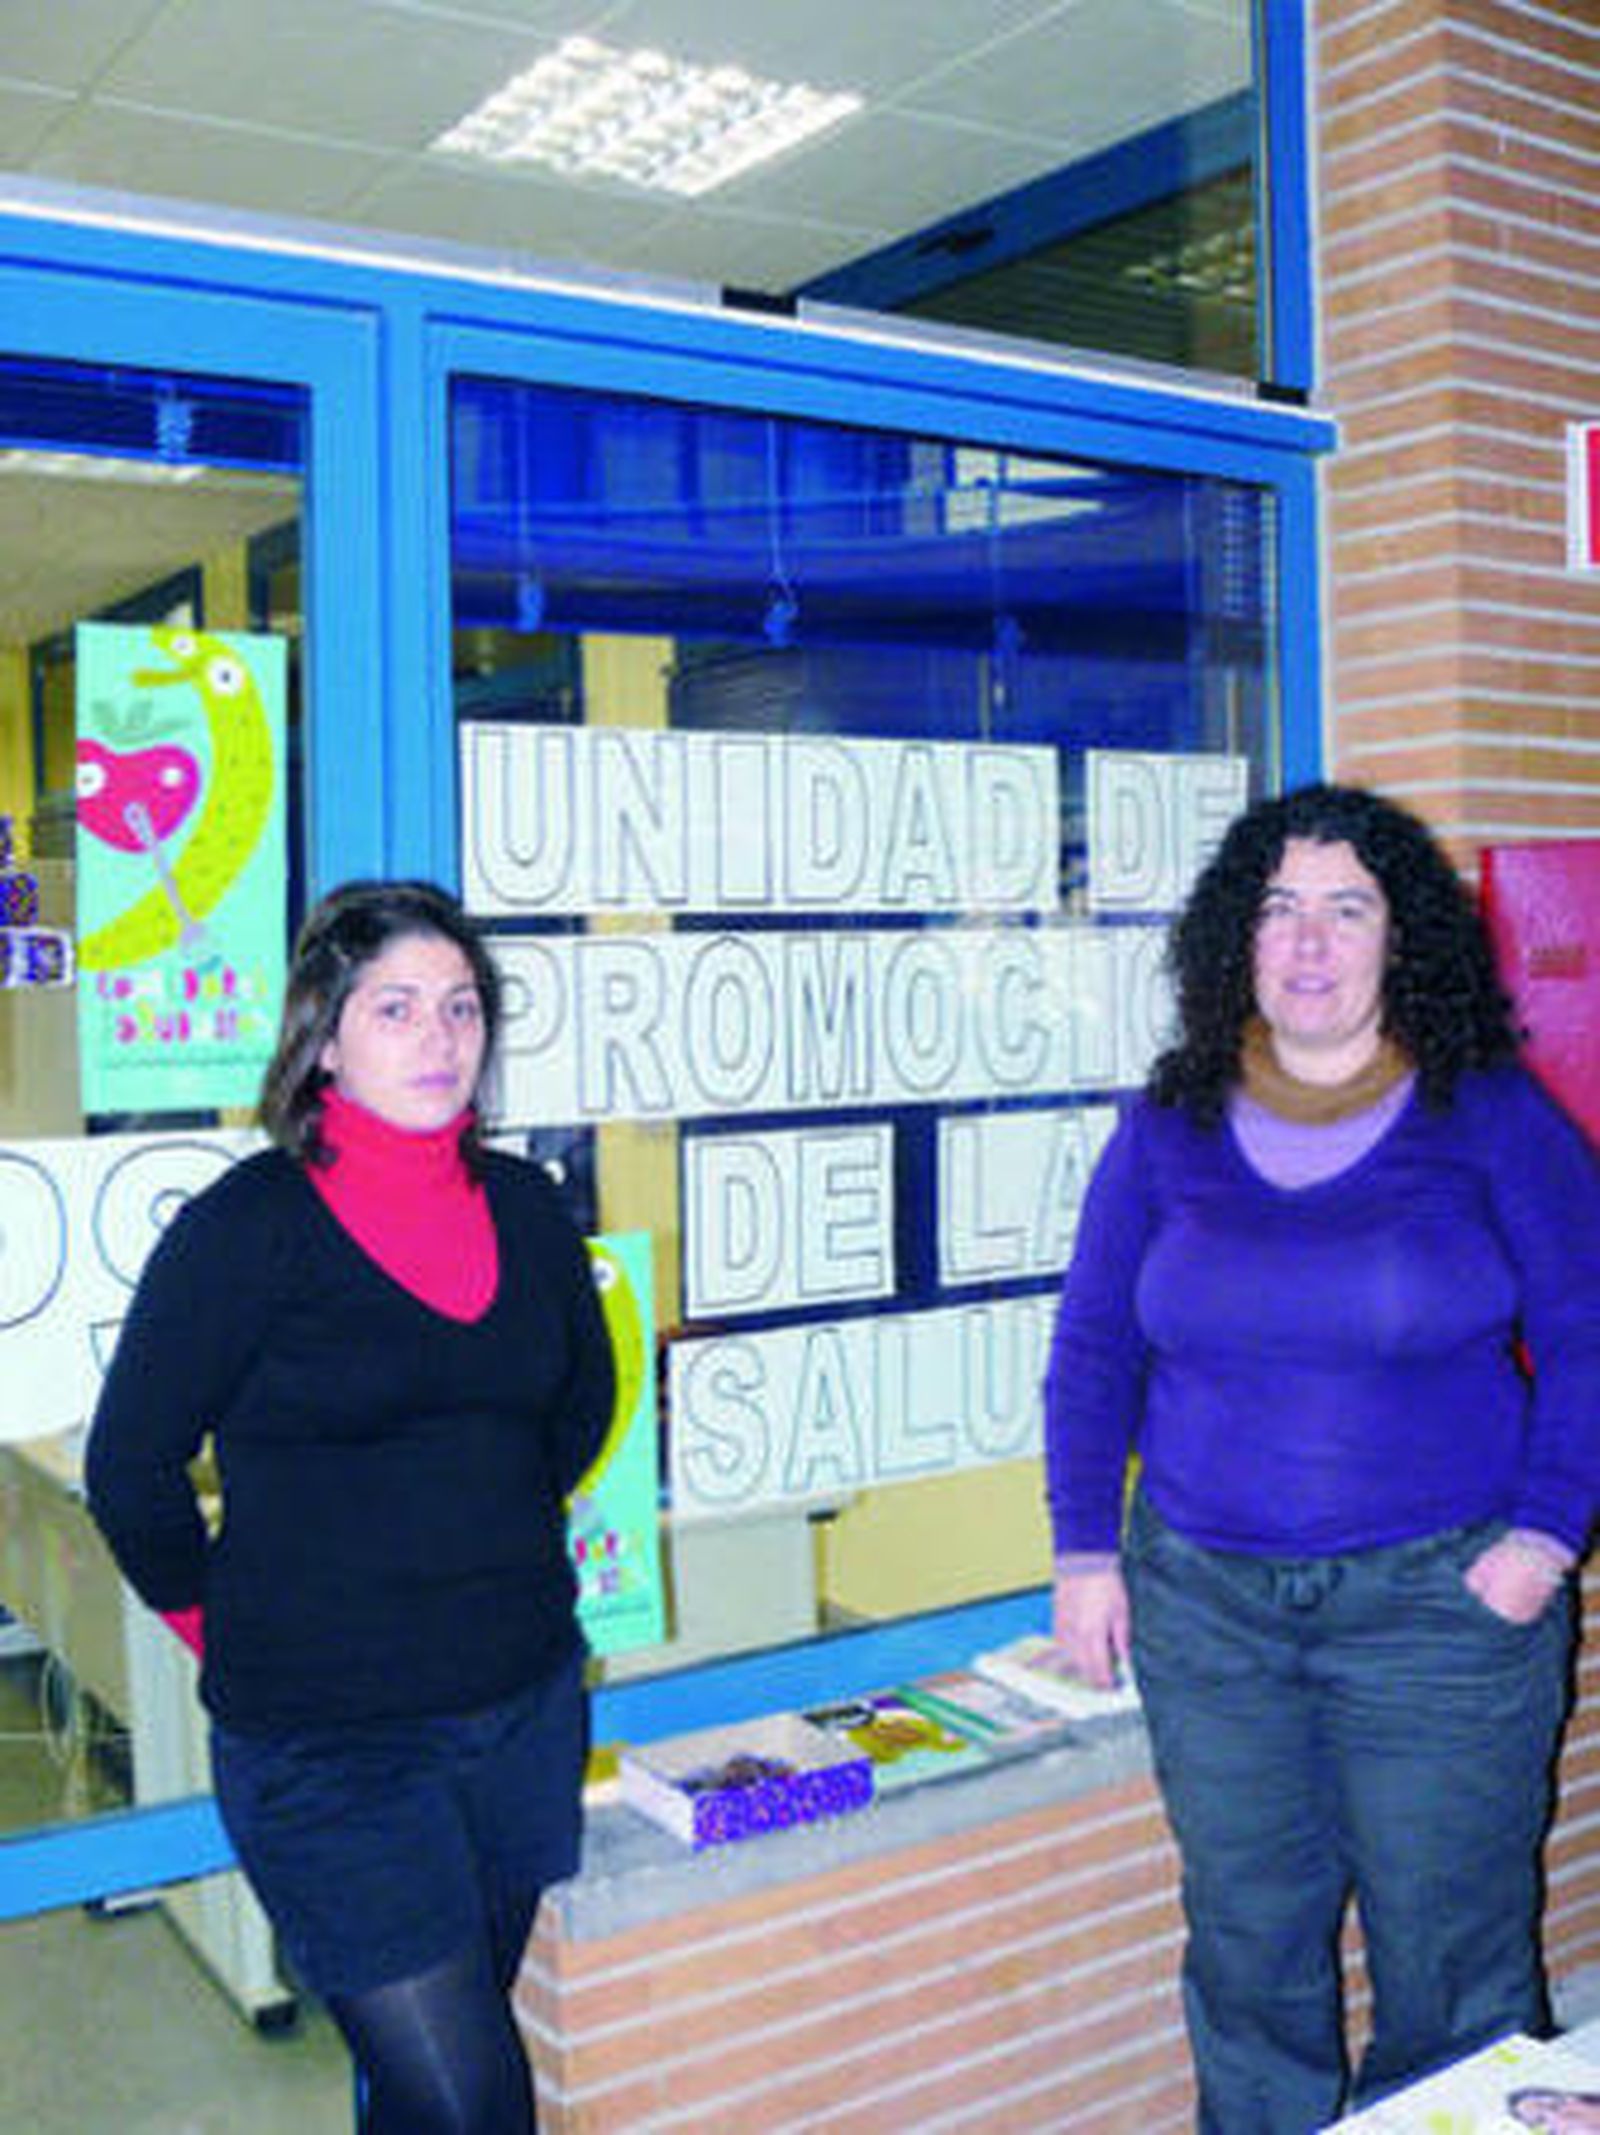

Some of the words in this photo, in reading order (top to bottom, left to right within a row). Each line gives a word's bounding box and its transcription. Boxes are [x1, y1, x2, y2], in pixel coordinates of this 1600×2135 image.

[471, 728, 1045, 905] UNIDAD
[1095, 753, 1243, 904] DE
[692, 1130, 886, 1311] DE
